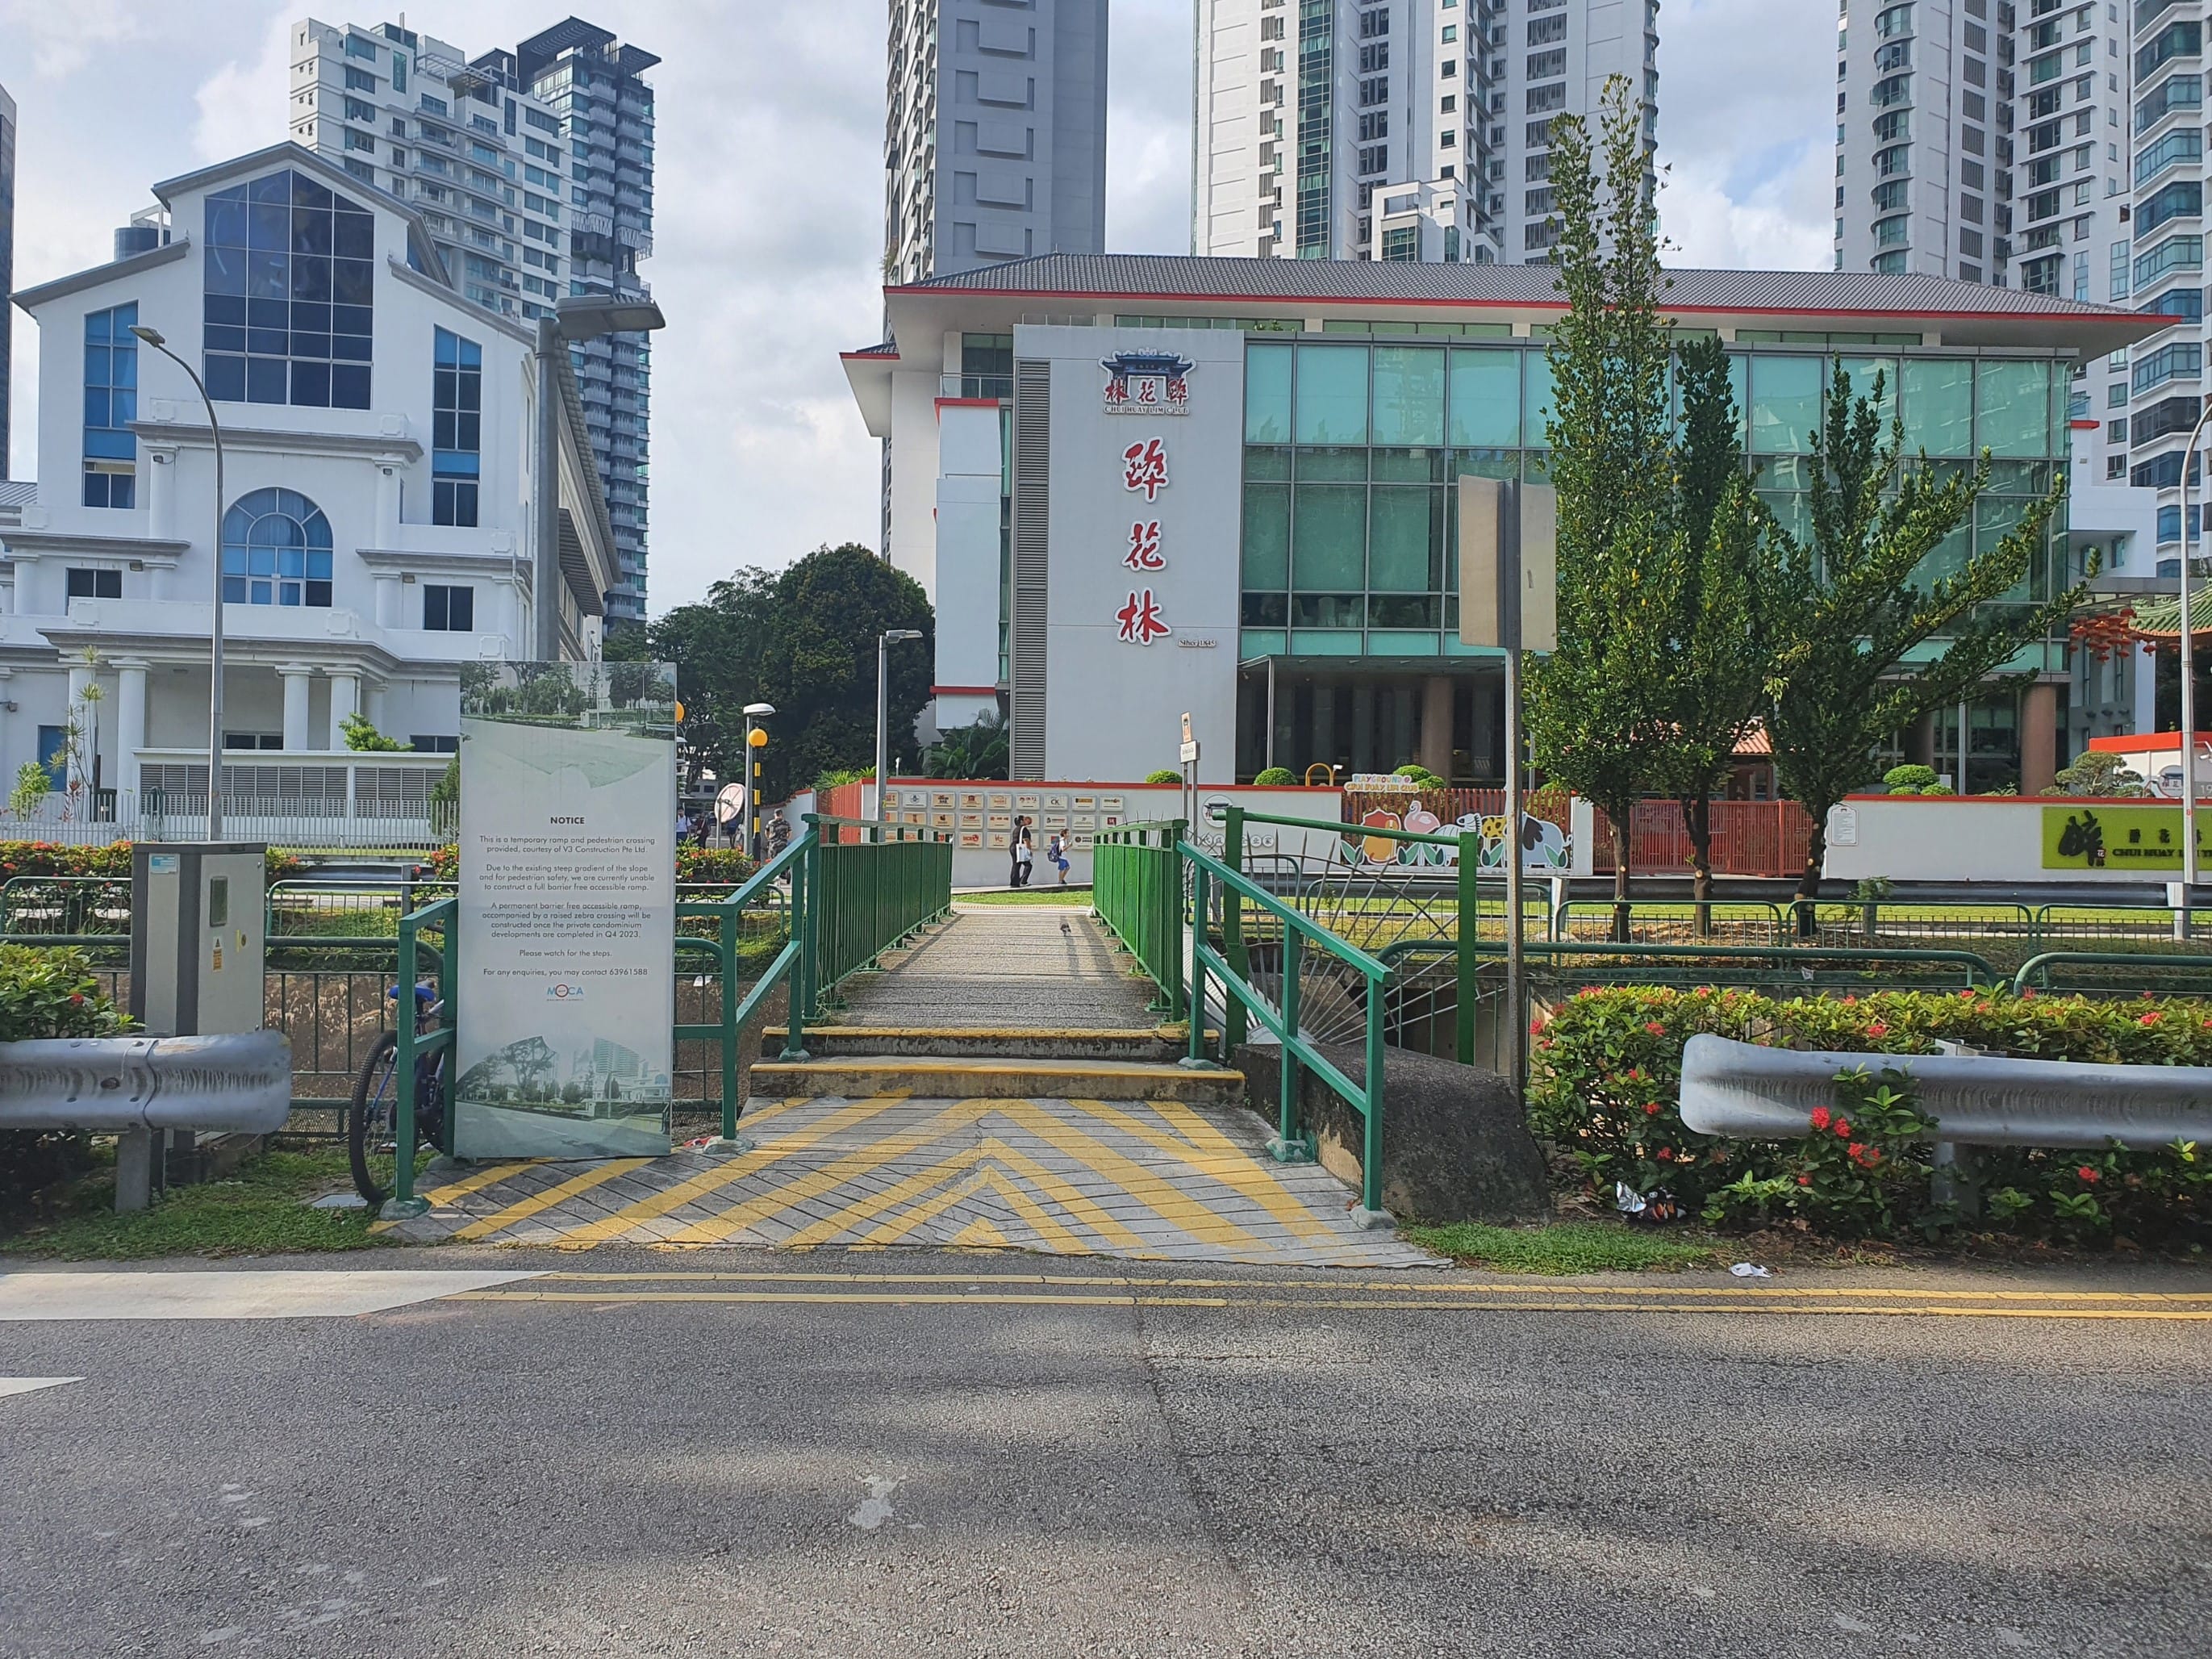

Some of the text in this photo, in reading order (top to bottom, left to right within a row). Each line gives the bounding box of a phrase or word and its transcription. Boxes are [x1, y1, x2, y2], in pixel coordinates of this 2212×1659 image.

[1166, 407, 1188, 415] CLUB
[1354, 775, 1402, 784] PLAYGROUND
[550, 817, 587, 825] NOTICE
[510, 837, 549, 845] temporary
[586, 836, 624, 845] pedestrian
[625, 837, 655, 845] crossing
[486, 846, 521, 855] provided,
[522, 846, 553, 855] courtesy
[2112, 849, 2142, 857] CHUI
[2144, 849, 2174, 857] HUAY
[525, 865, 552, 874] existing
[554, 866, 573, 874] steep
[574, 865, 604, 874] gradient
[629, 865, 648, 874] slope
[507, 874, 545, 883] pedestrian
[547, 874, 569, 883] safety,
[597, 874, 628, 883] currently
[499, 903, 538, 911] permanent
[482, 912, 531, 921] accompanied
[532, 912, 542, 921] by
[596, 913, 626, 921] crossing
[566, 922, 591, 930] private
[490, 930, 541, 939] developments
[557, 930, 595, 939] completed
[593, 951, 611, 959] steps.
[511, 969, 547, 977] enquiries,
[547, 984, 583, 997] MOCA
